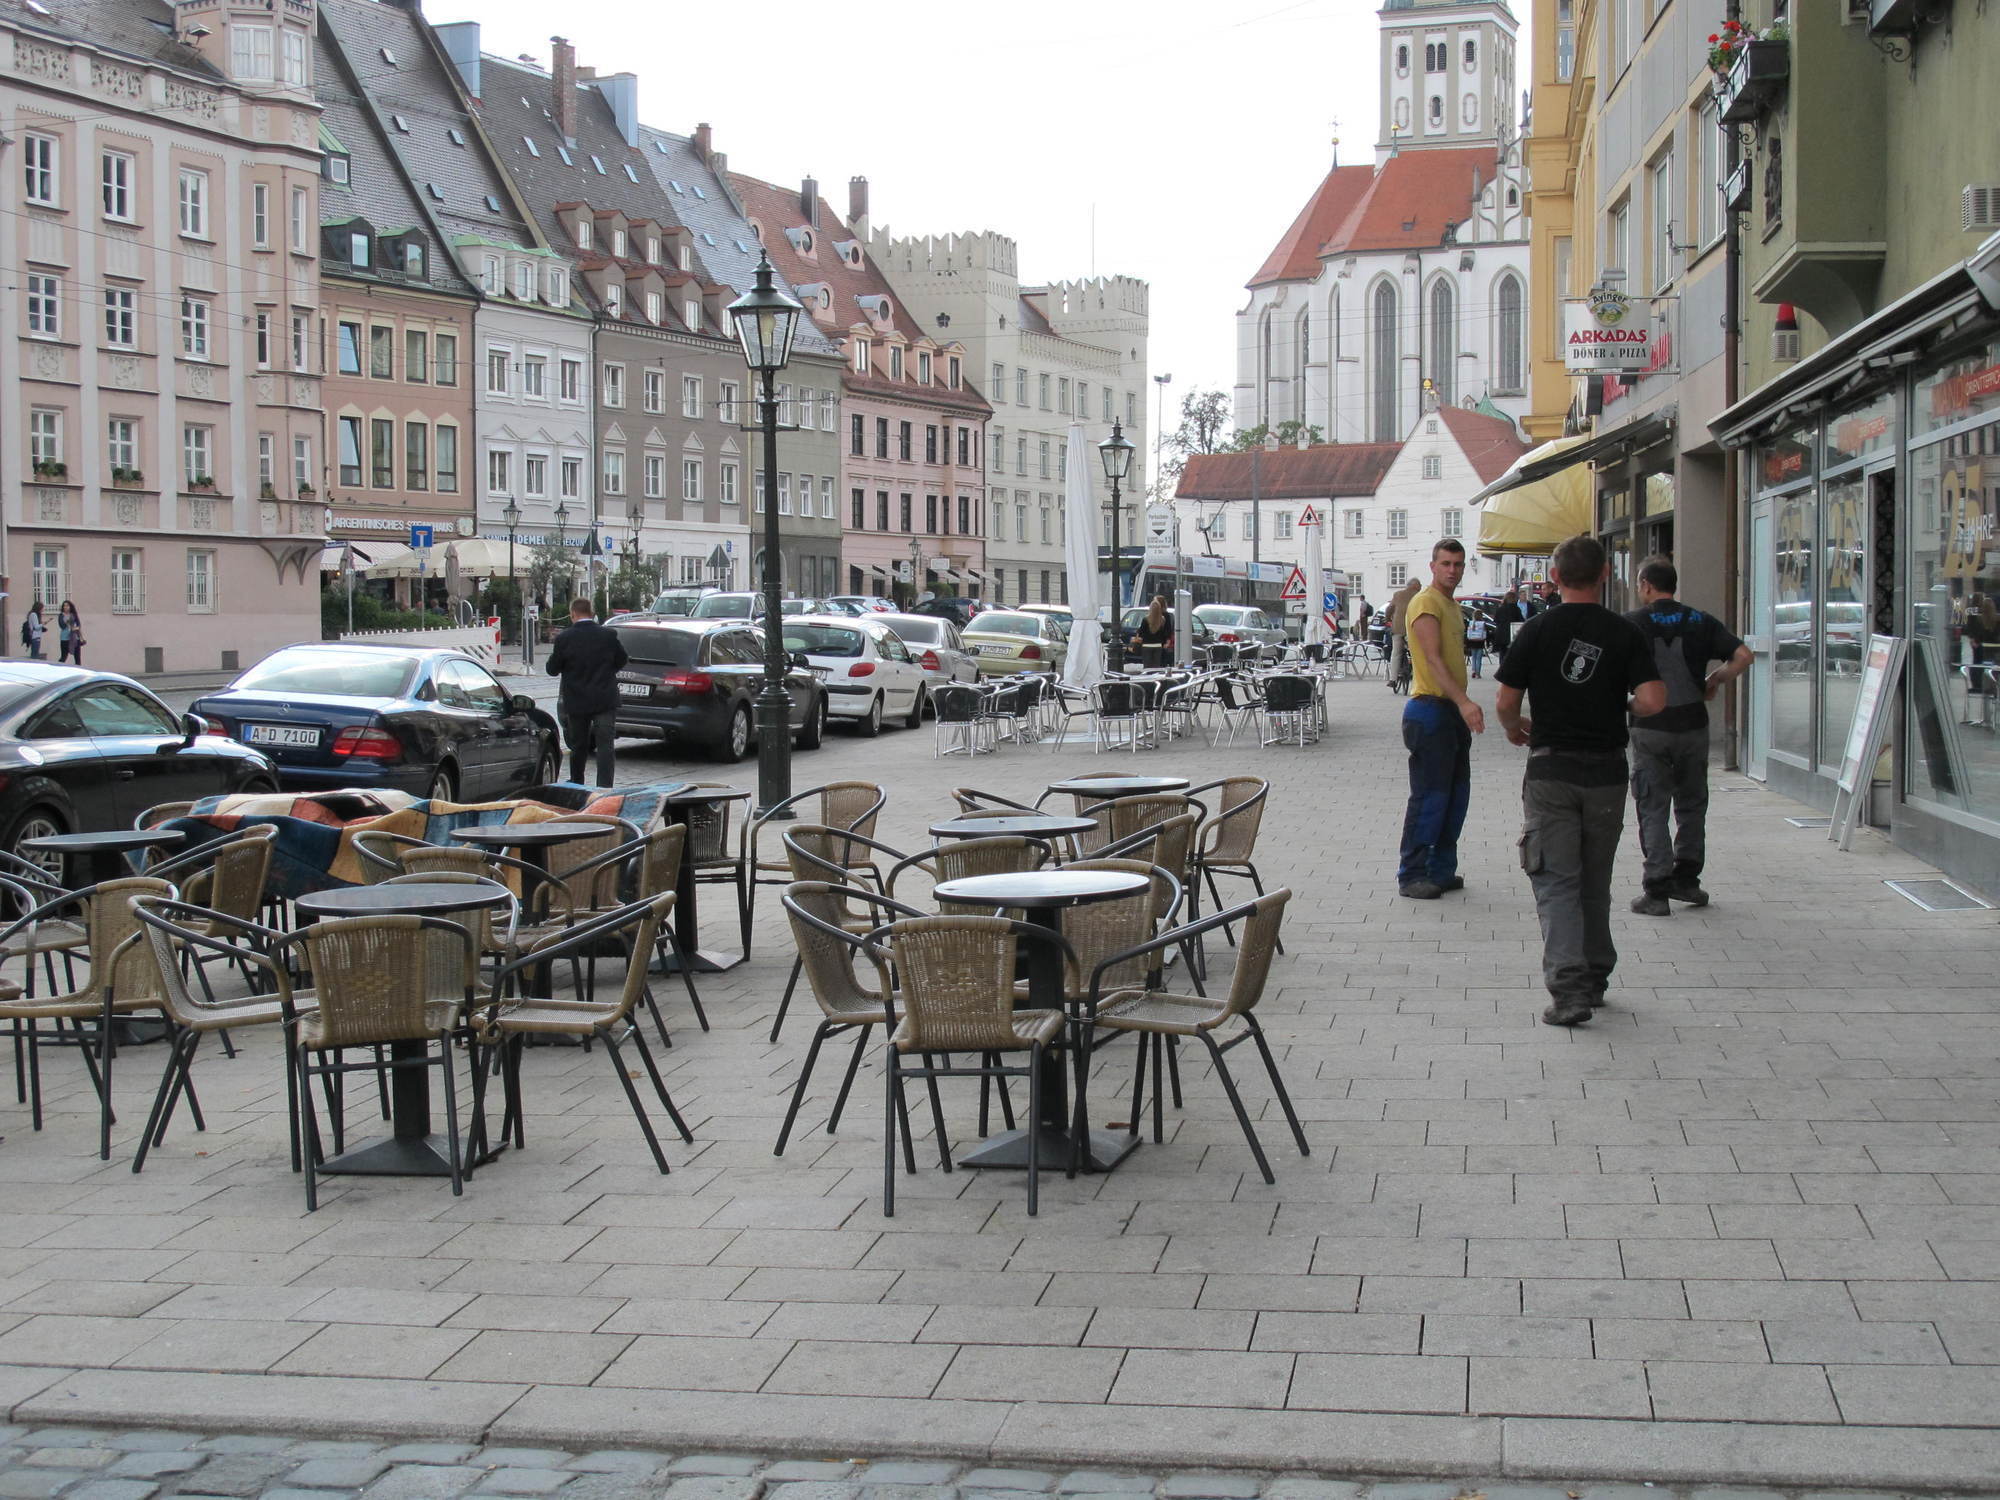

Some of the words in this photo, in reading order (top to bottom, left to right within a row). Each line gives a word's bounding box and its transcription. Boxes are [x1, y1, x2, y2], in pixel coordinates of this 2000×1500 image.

[1593, 292, 1627, 304] Ayinger
[1568, 329, 1648, 344] ARKADAŞ
[1573, 347, 1606, 359] DÖNER
[1619, 347, 1647, 358] PIZZA
[1942, 467, 1980, 577] 25
[517, 535, 546, 545] DEMEL
[253, 728, 259, 740] A
[269, 729, 277, 741] D
[284, 730, 316, 744] 7100
